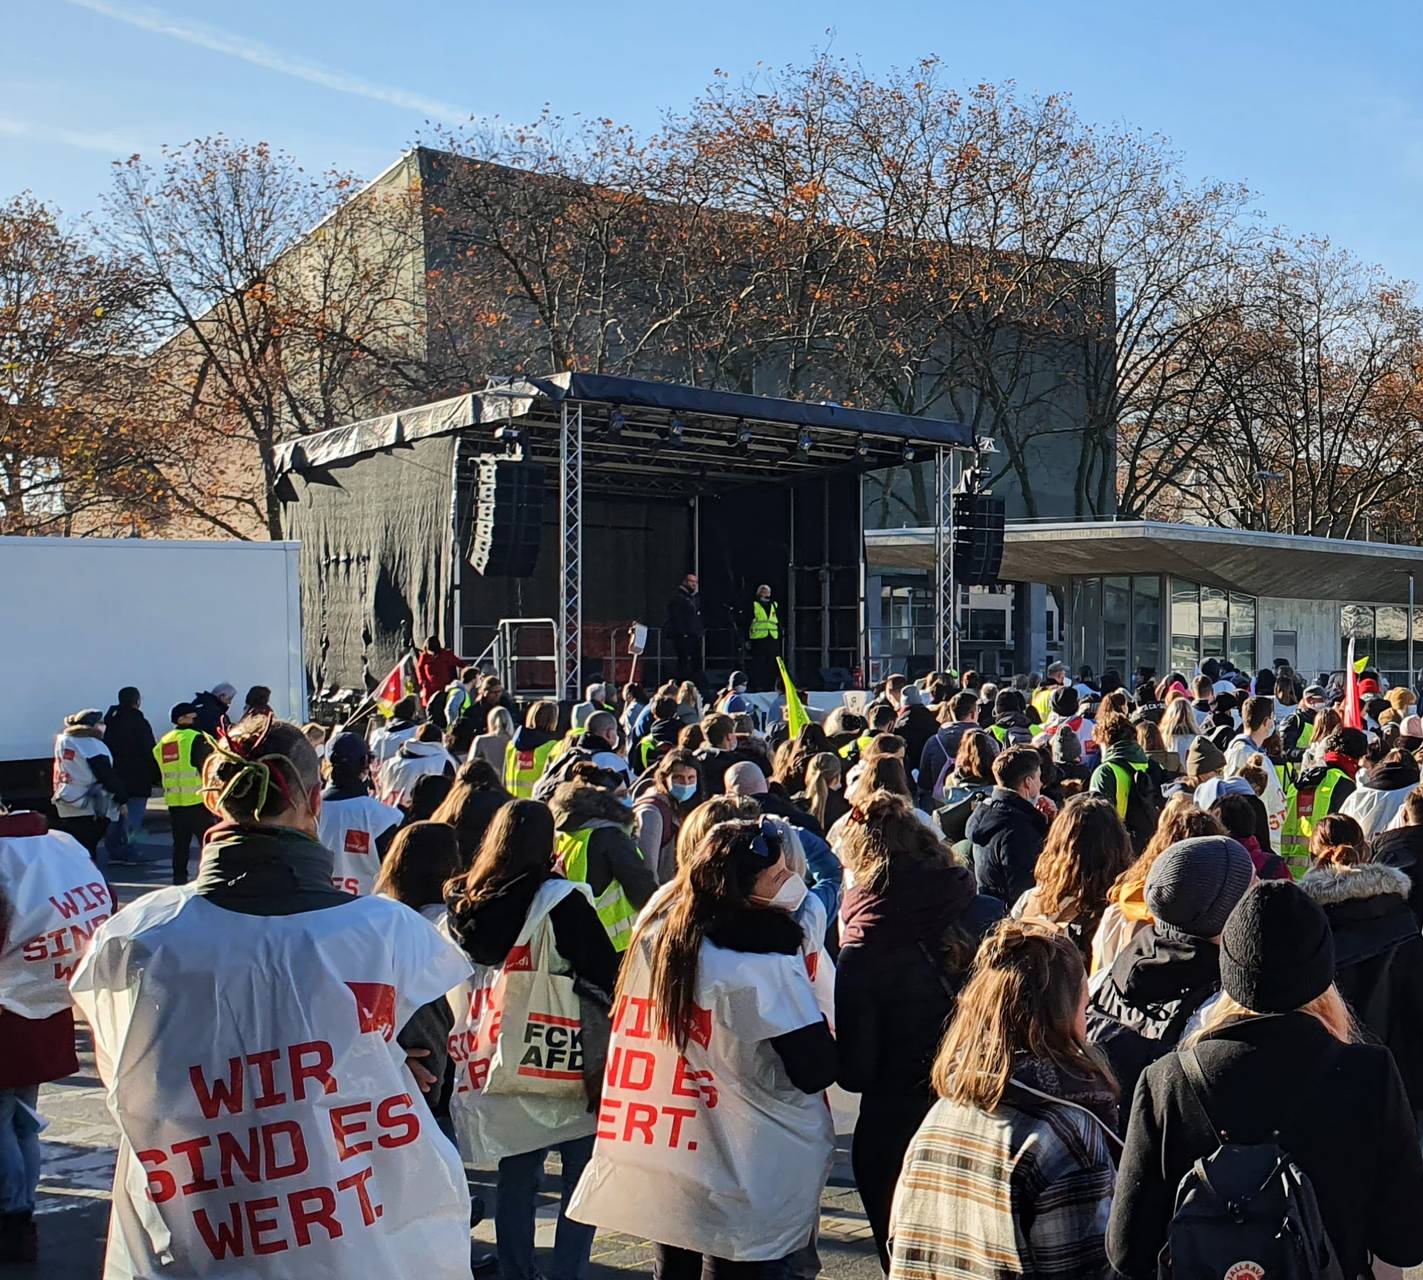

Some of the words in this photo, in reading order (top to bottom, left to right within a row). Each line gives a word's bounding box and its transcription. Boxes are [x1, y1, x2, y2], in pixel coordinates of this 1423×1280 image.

[520, 1045, 585, 1071] AFD
[524, 1022, 584, 1050] FCK
[189, 1040, 338, 1120] WIR
[137, 1119, 309, 1204] SIND
[329, 1092, 421, 1162] ES
[193, 1166, 384, 1261] WERT.
